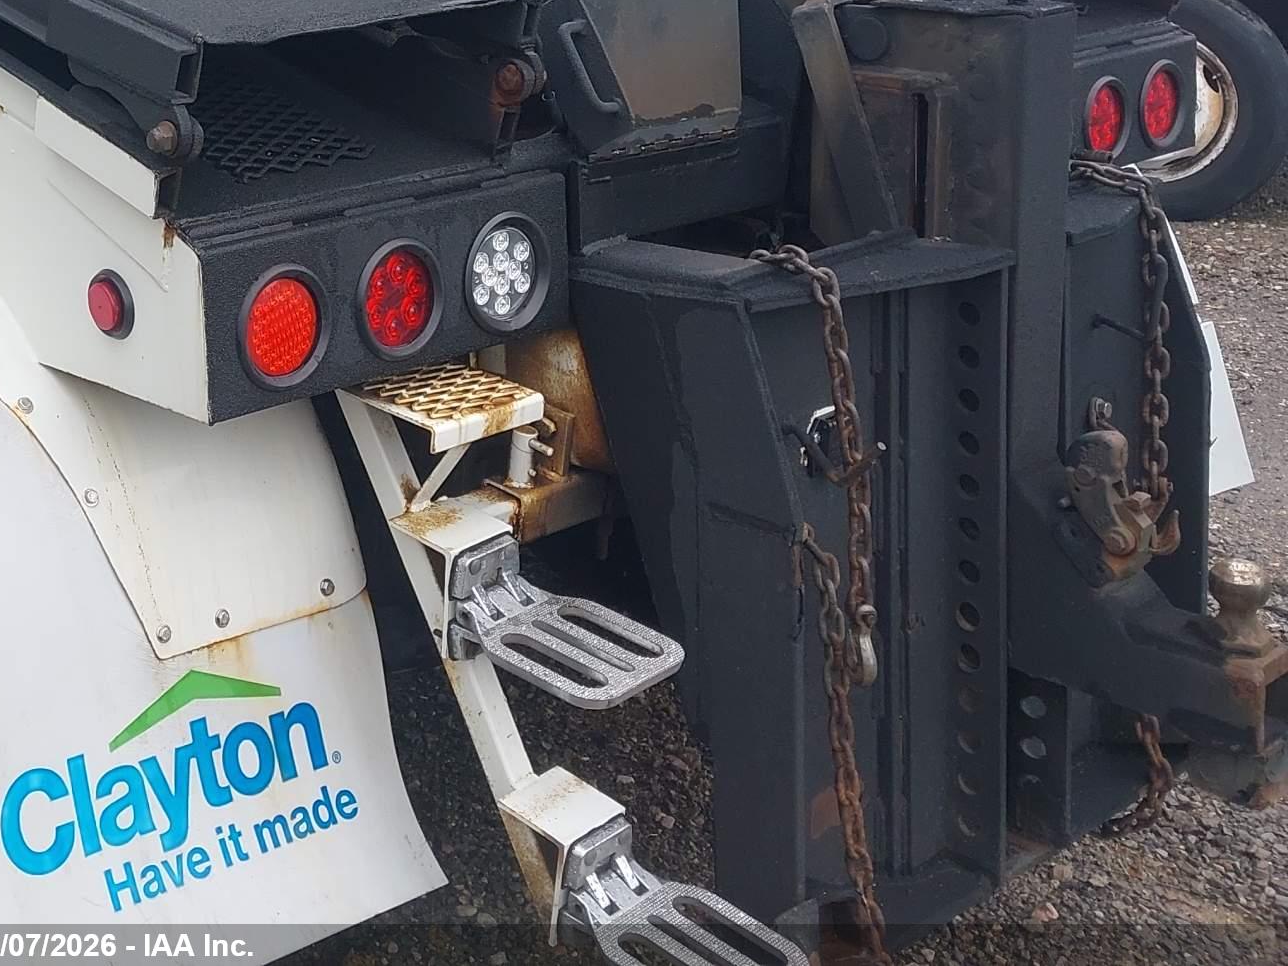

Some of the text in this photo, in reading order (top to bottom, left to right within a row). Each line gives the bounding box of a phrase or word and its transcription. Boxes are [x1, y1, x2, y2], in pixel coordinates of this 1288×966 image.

[0, 702, 328, 875] Clayton
[103, 785, 359, 913] Have it made
